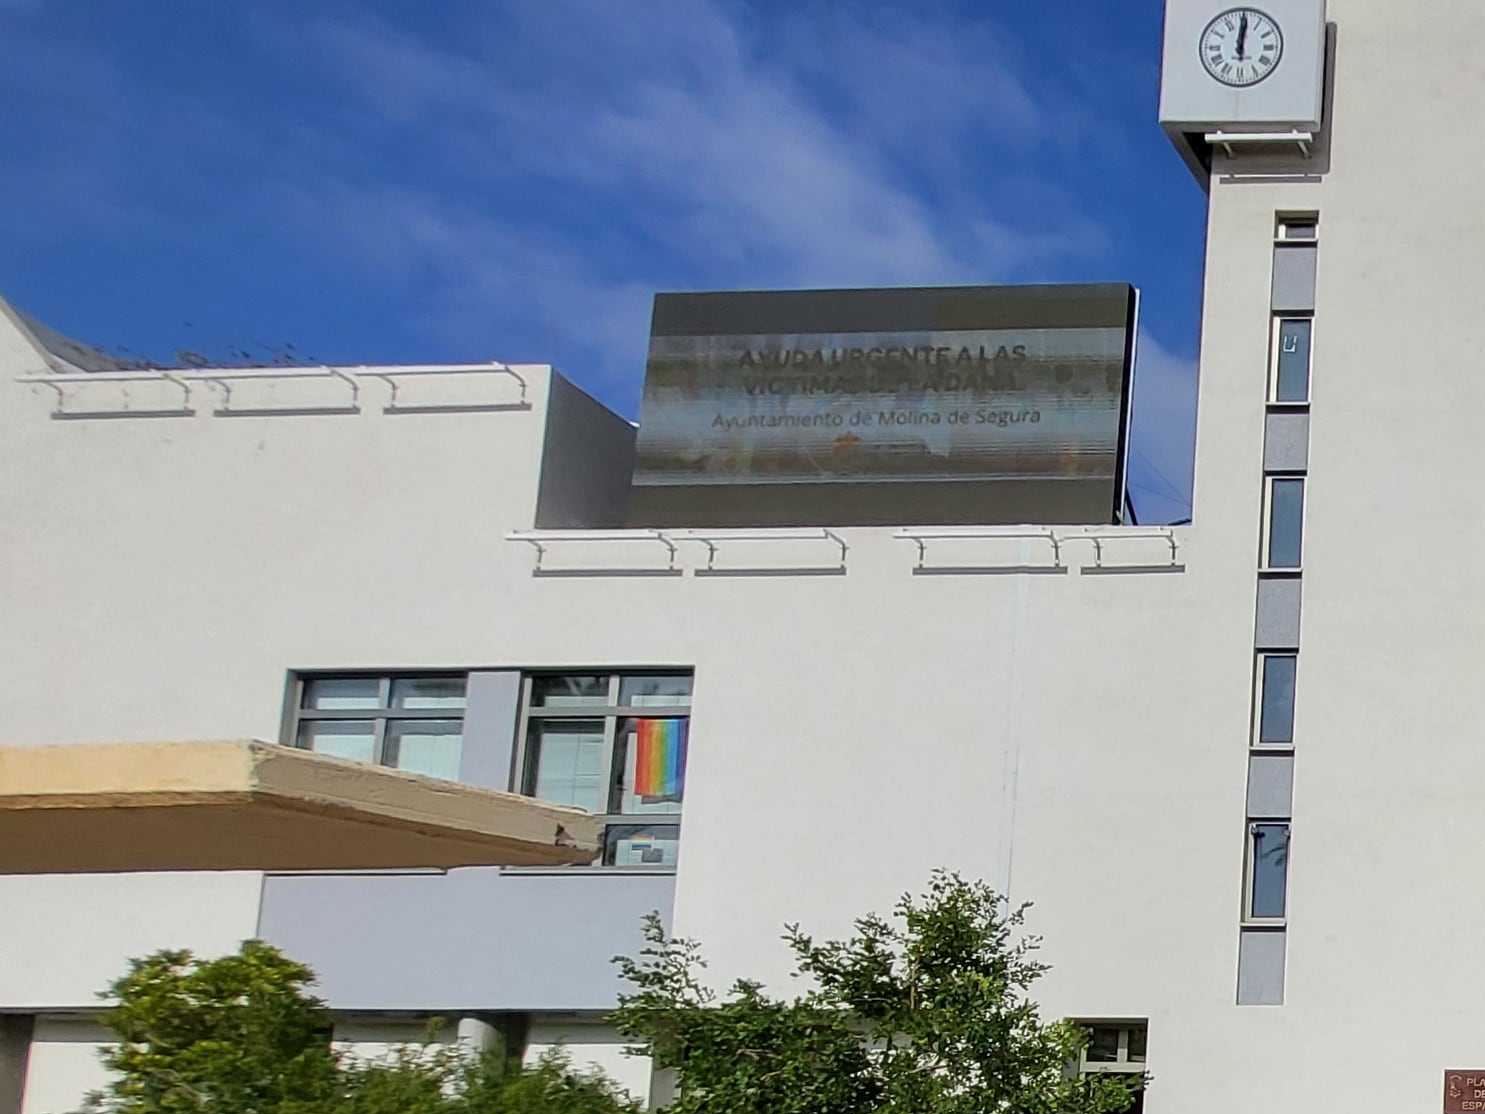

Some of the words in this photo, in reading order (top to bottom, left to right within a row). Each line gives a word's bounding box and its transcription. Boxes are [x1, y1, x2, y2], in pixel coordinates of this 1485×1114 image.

[738, 349, 824, 369] AYUDA
[831, 346, 951, 368] URGENTE
[979, 343, 1027, 364] LAS
[743, 374, 858, 396] VICTIMA
[711, 412, 843, 430] Ayuntamiento
[850, 410, 873, 426] de
[878, 409, 941, 426] Molina
[948, 408, 969, 425] de
[975, 408, 1041, 428] Segura
